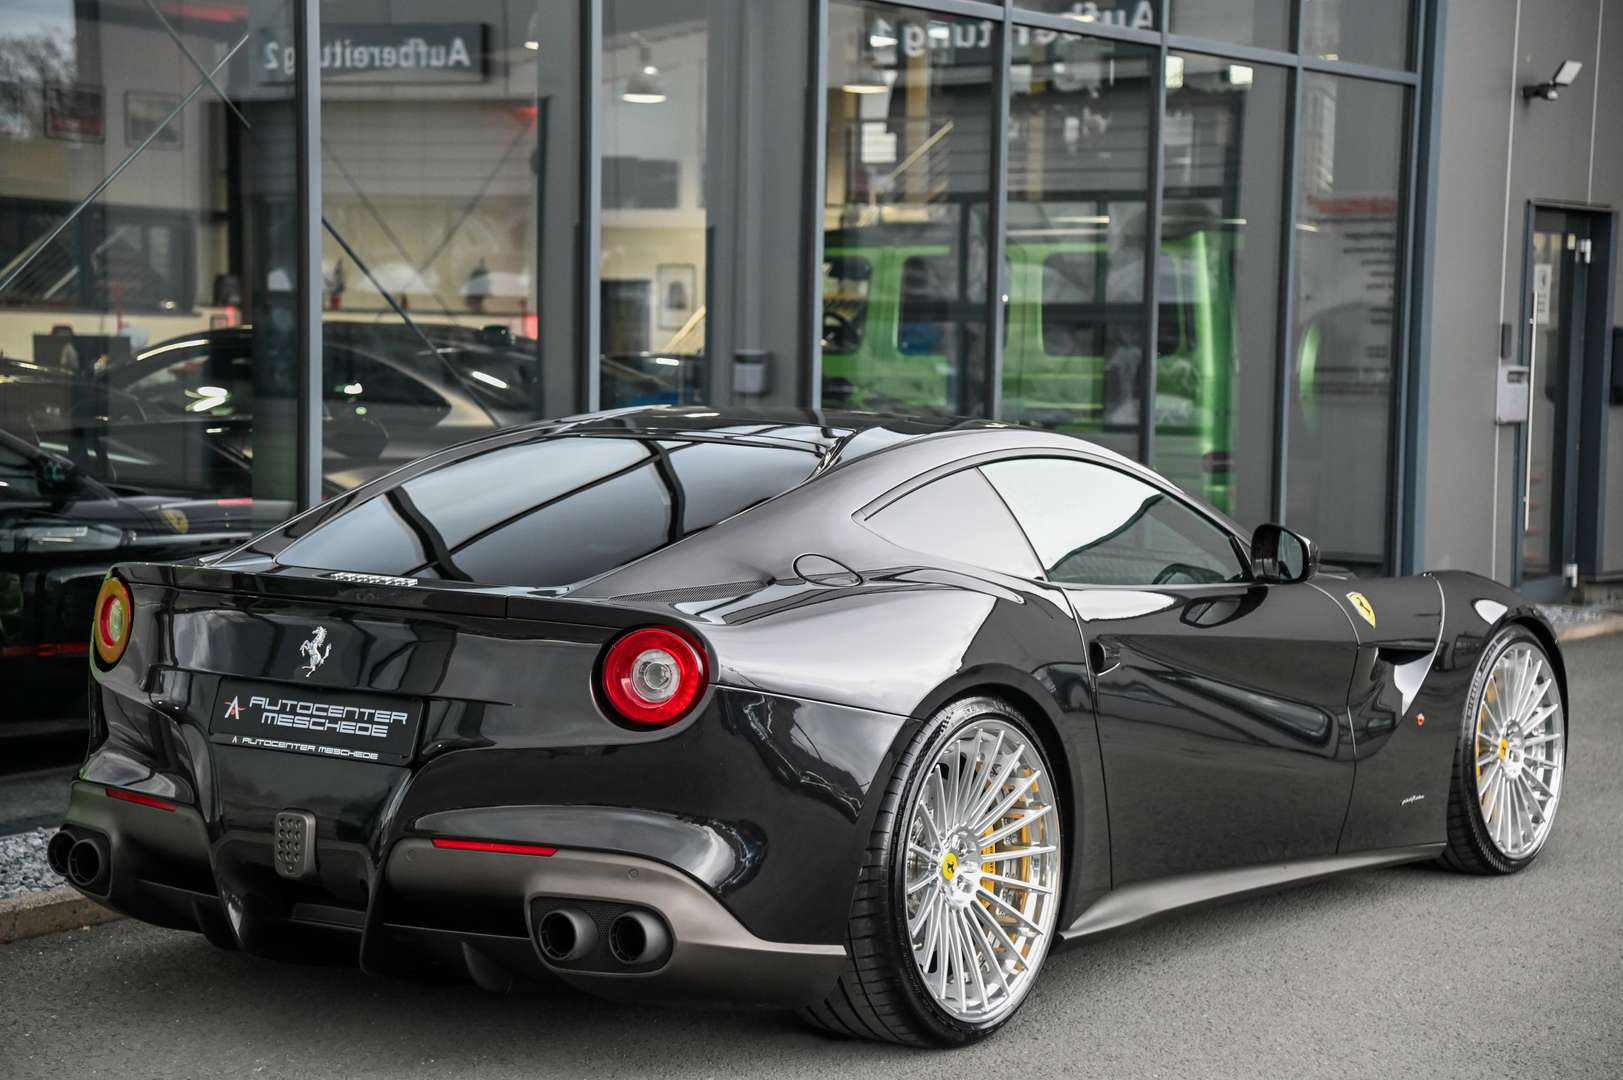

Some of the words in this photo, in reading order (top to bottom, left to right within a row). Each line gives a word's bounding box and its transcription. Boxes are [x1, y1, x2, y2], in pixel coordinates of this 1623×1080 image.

[249, 695, 408, 725] AUTOCENTER
[261, 712, 388, 738] MESCHEDE
[242, 737, 316, 752] AUTOCENTER
[318, 746, 379, 760] MESCHEDE
